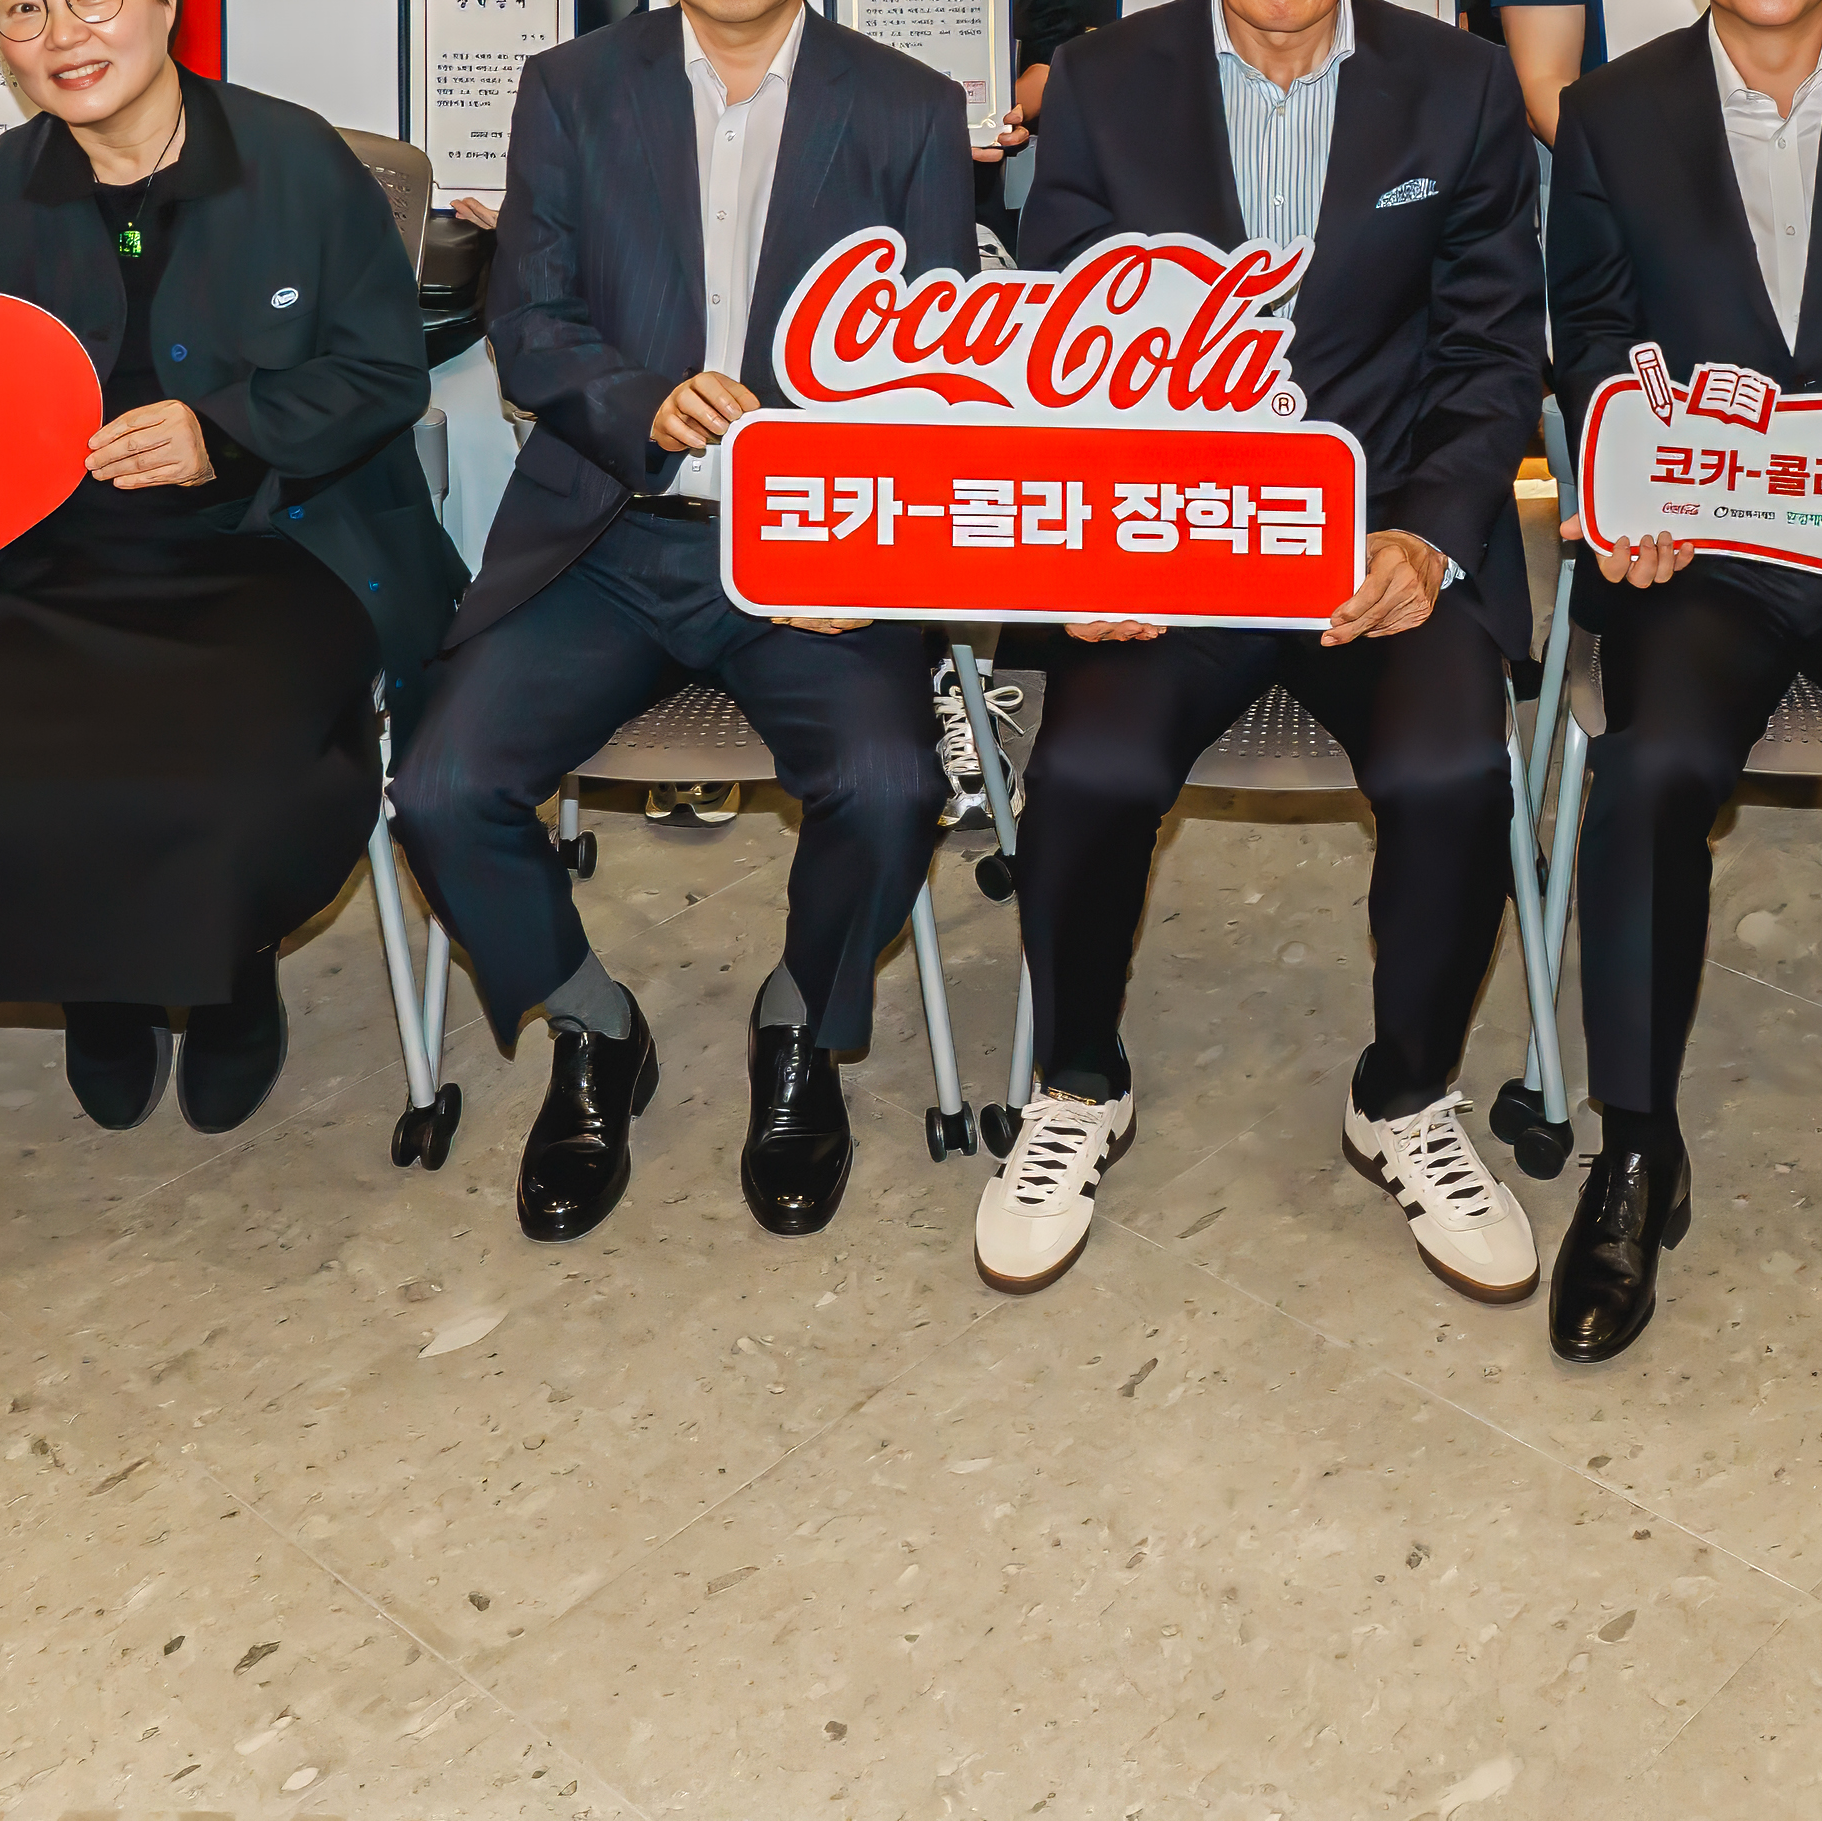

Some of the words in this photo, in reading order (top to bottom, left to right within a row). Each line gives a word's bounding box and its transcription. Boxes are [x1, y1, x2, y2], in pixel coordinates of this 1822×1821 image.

[784, 238, 1303, 412] Coca-Cola
[760, 476, 1092, 551] 코카-콜라
[1111, 481, 1326, 558] 장학금
